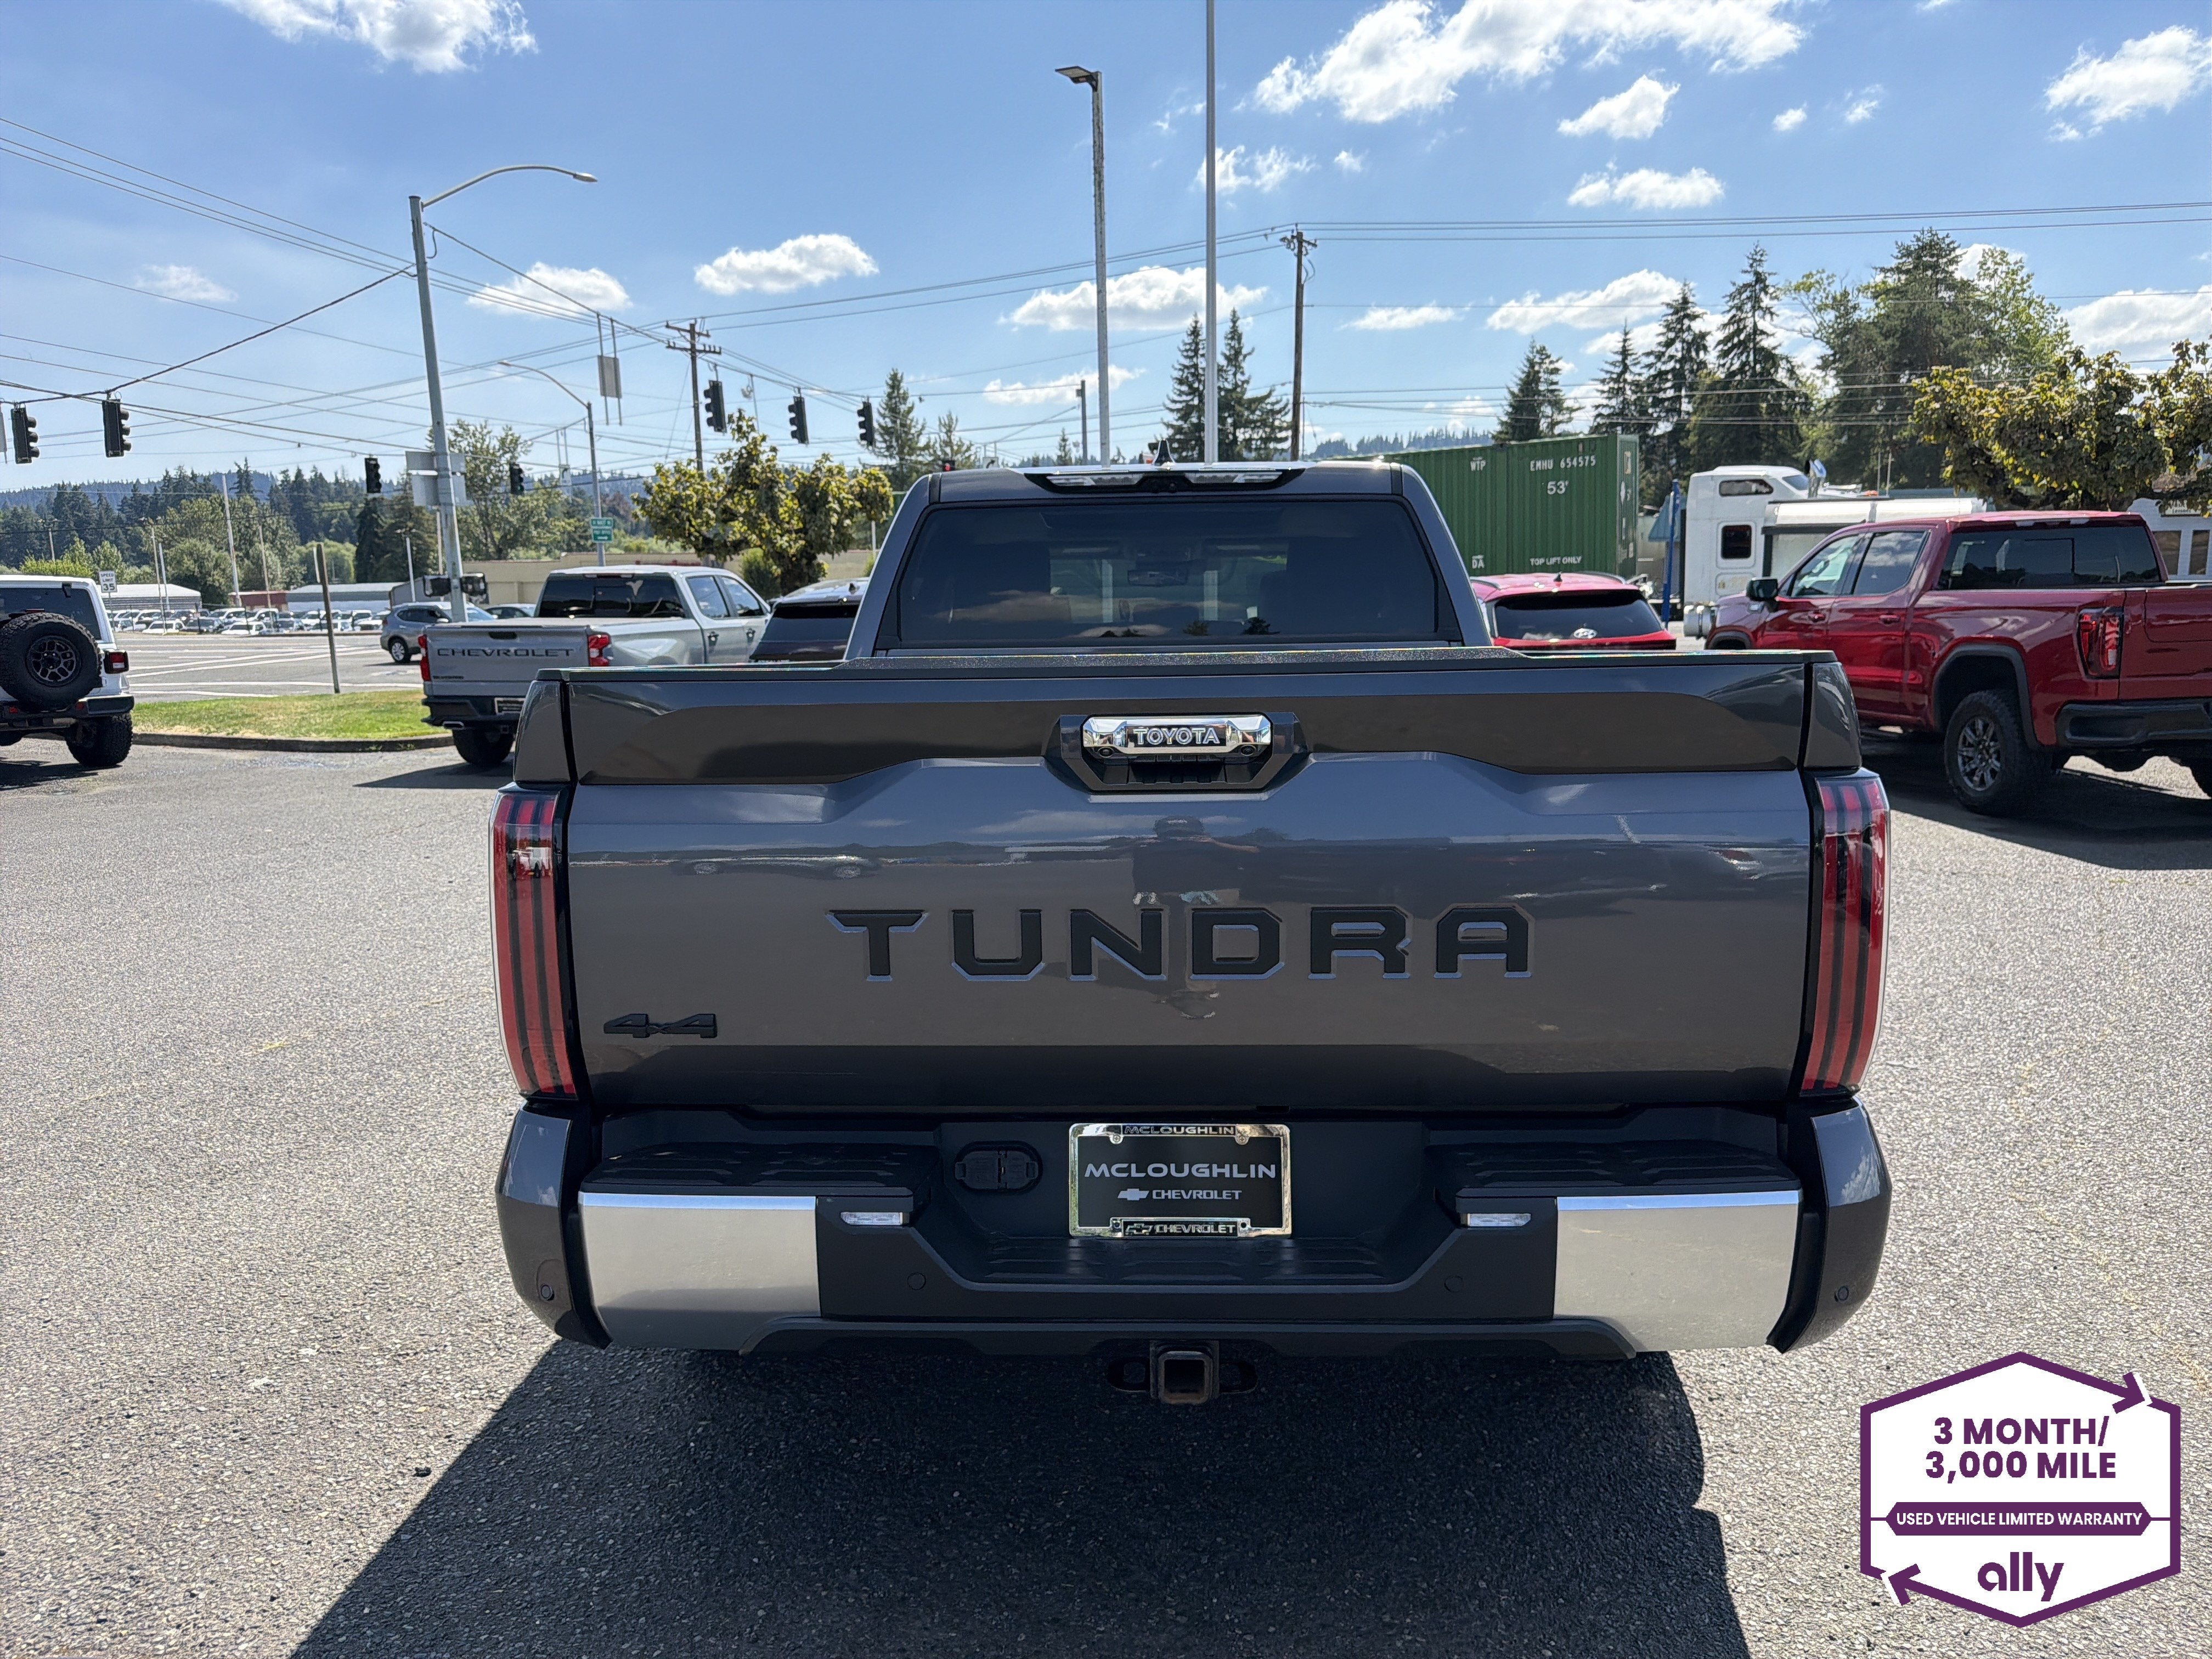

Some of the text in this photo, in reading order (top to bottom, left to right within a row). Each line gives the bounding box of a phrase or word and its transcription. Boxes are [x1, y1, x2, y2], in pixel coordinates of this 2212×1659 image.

[1470, 460, 1486, 471] WTP
[1530, 455, 1596, 471] EMHU 654575
[1530, 555, 1582, 566] TOP LIFT ONLY
[437, 648, 574, 657] CHEVROLET
[1132, 727, 1221, 745] TOYOTA
[825, 905, 1532, 983] TUNDRA
[1124, 1126, 1234, 1135] MCLOUGHLIN
[1085, 1163, 1276, 1178] MCLOUGHLIN
[1152, 1190, 1242, 1200] CHEVROLET
[1155, 1224, 1235, 1234] CHEVROLET
